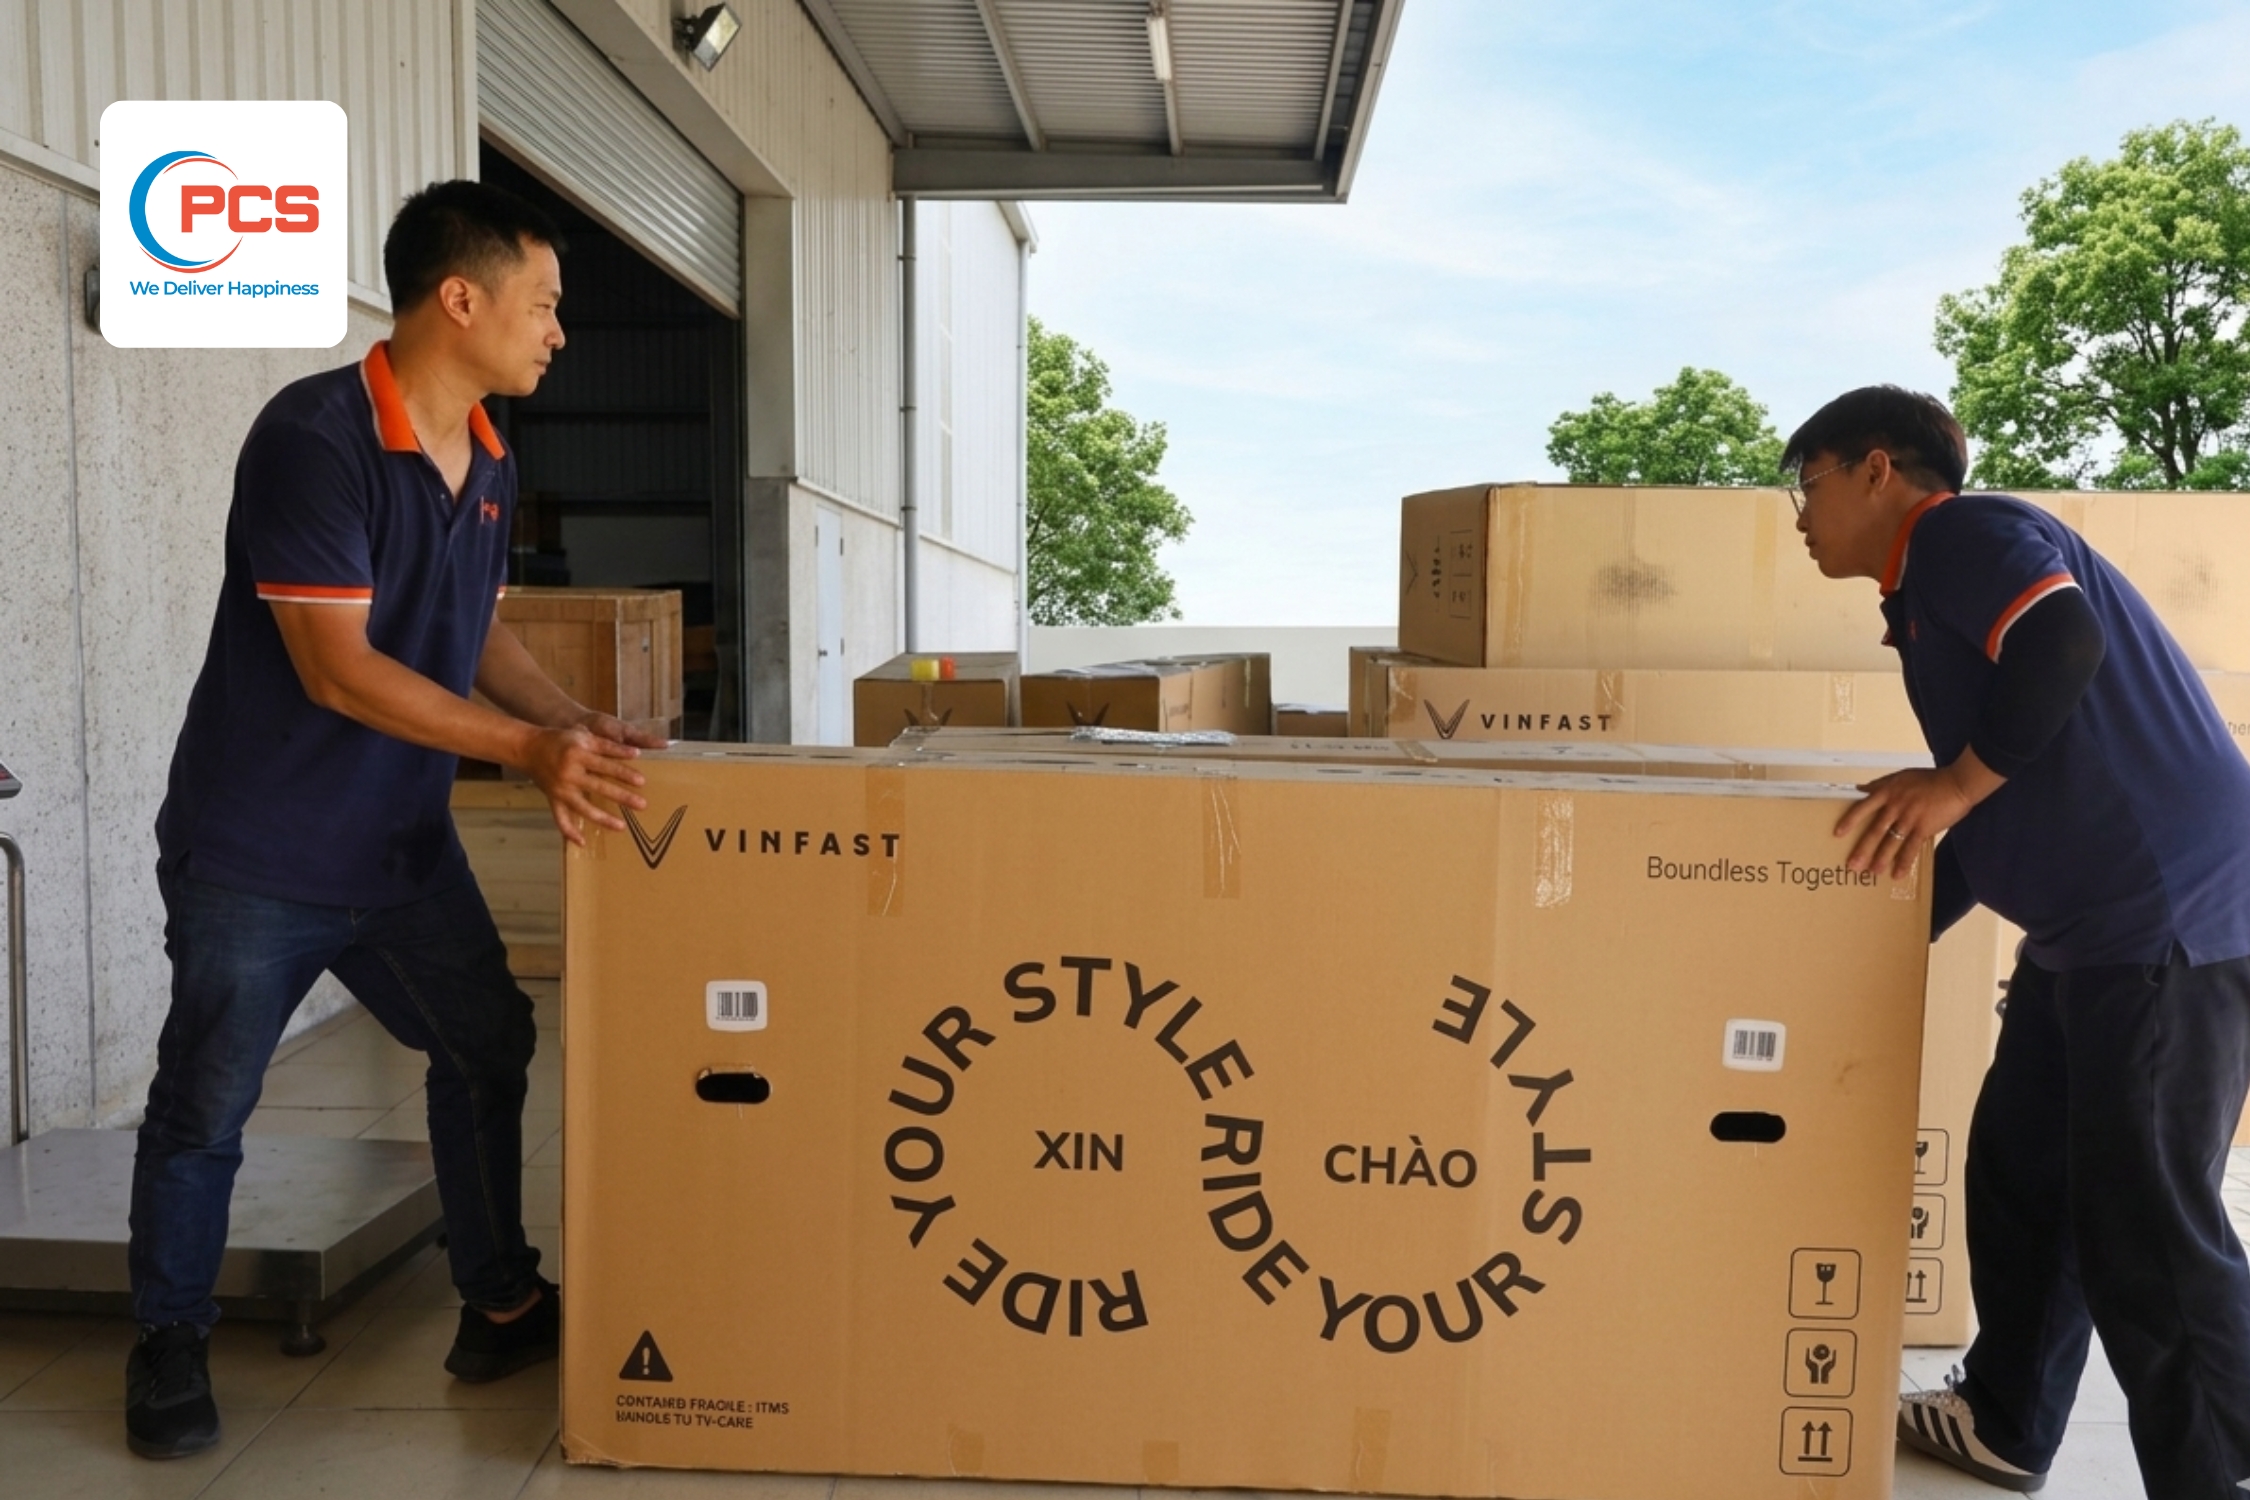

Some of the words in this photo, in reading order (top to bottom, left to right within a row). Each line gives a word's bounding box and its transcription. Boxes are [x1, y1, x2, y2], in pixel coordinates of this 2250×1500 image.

[1481, 713, 1611, 732] VINFAST
[704, 828, 900, 858] VINFAST
[1647, 855, 1769, 884] Boundless
[1003, 955, 1255, 1101] STYLE
[884, 1005, 996, 1249] YOUR
[1034, 1130, 1123, 1171] XIN
[1431, 974, 1592, 1245] STYLE
[1200, 1113, 1310, 1306] RIDE
[1324, 1135, 1477, 1188] CHÀO
[942, 1237, 1149, 1337] RIDE
[1319, 1250, 1546, 1354] YOUR
